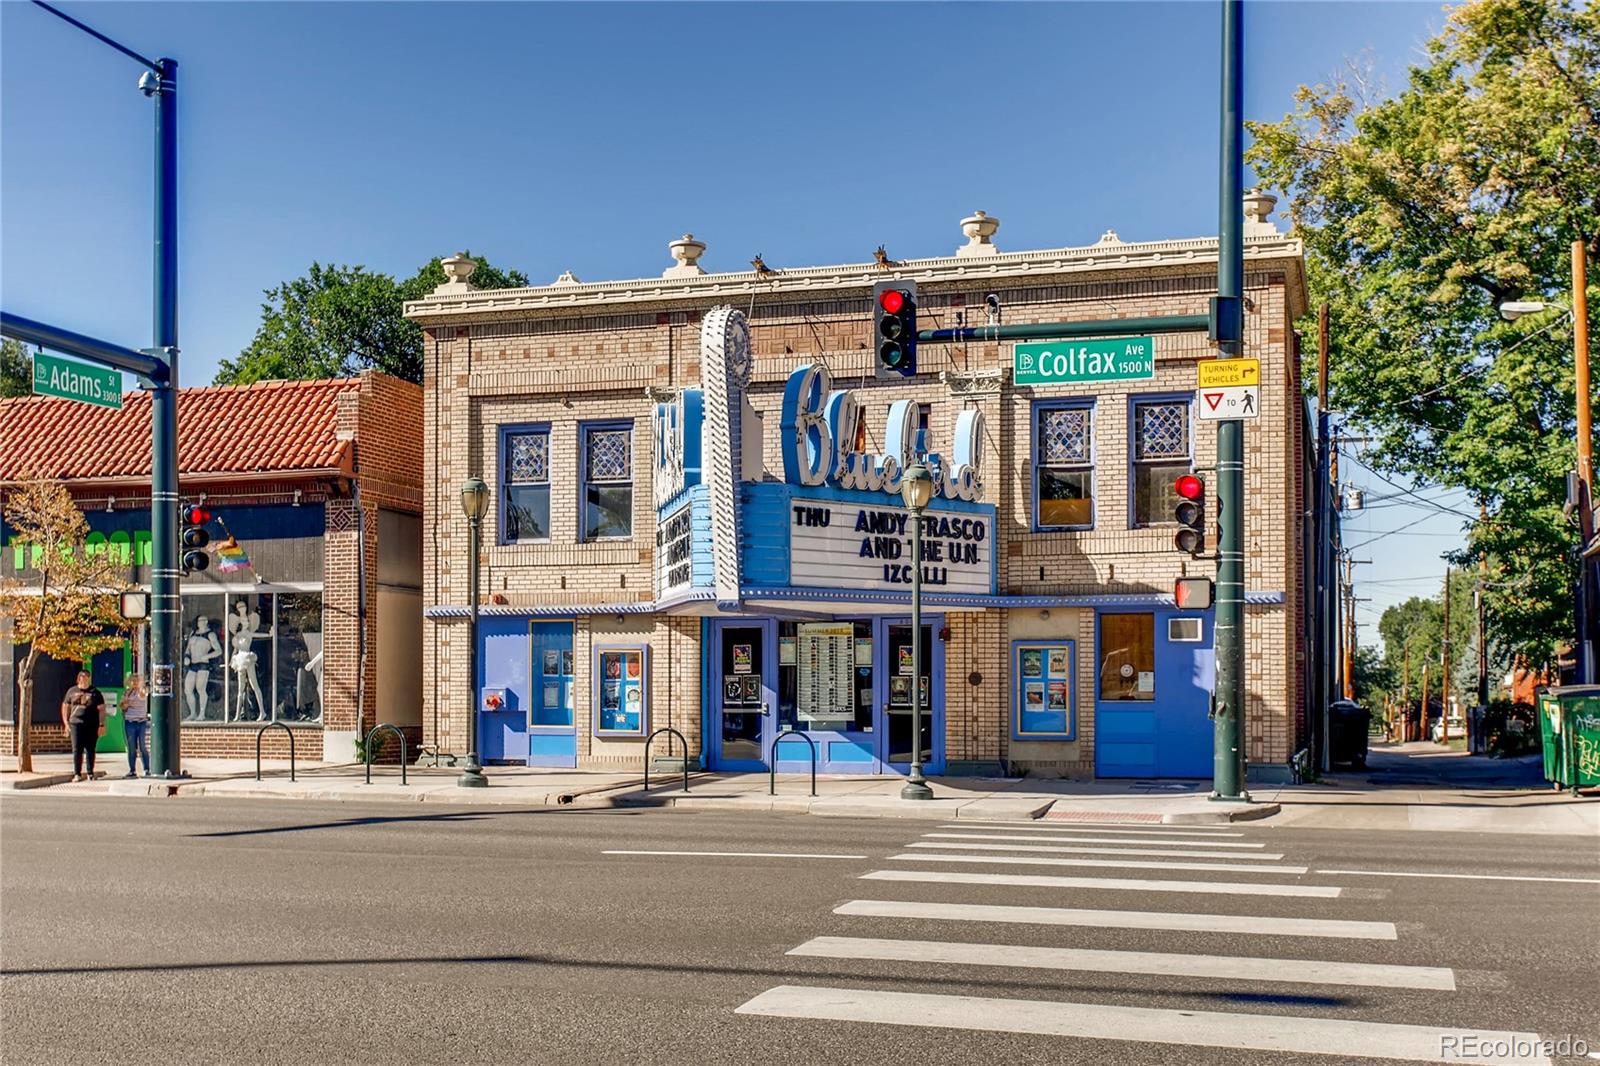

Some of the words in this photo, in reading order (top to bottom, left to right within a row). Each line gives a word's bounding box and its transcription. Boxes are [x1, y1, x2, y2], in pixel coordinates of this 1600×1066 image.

[1039, 348, 1116, 377] Colfax
[1125, 344, 1144, 356] Ave
[1119, 361, 1141, 374] 1500
[1144, 360, 1152, 372] N
[1204, 364, 1238, 373] TURNING
[50, 365, 101, 399] Adams
[108, 375, 115, 387] St
[1203, 375, 1240, 384] VEHICLES
[103, 390, 117, 403] 3300
[1226, 399, 1236, 407] TO
[793, 506, 831, 528] THU
[855, 510, 908, 535] ANDY
[916, 515, 985, 542] FRASCO
[859, 537, 902, 560] AND
[949, 542, 981, 565] U.N.
